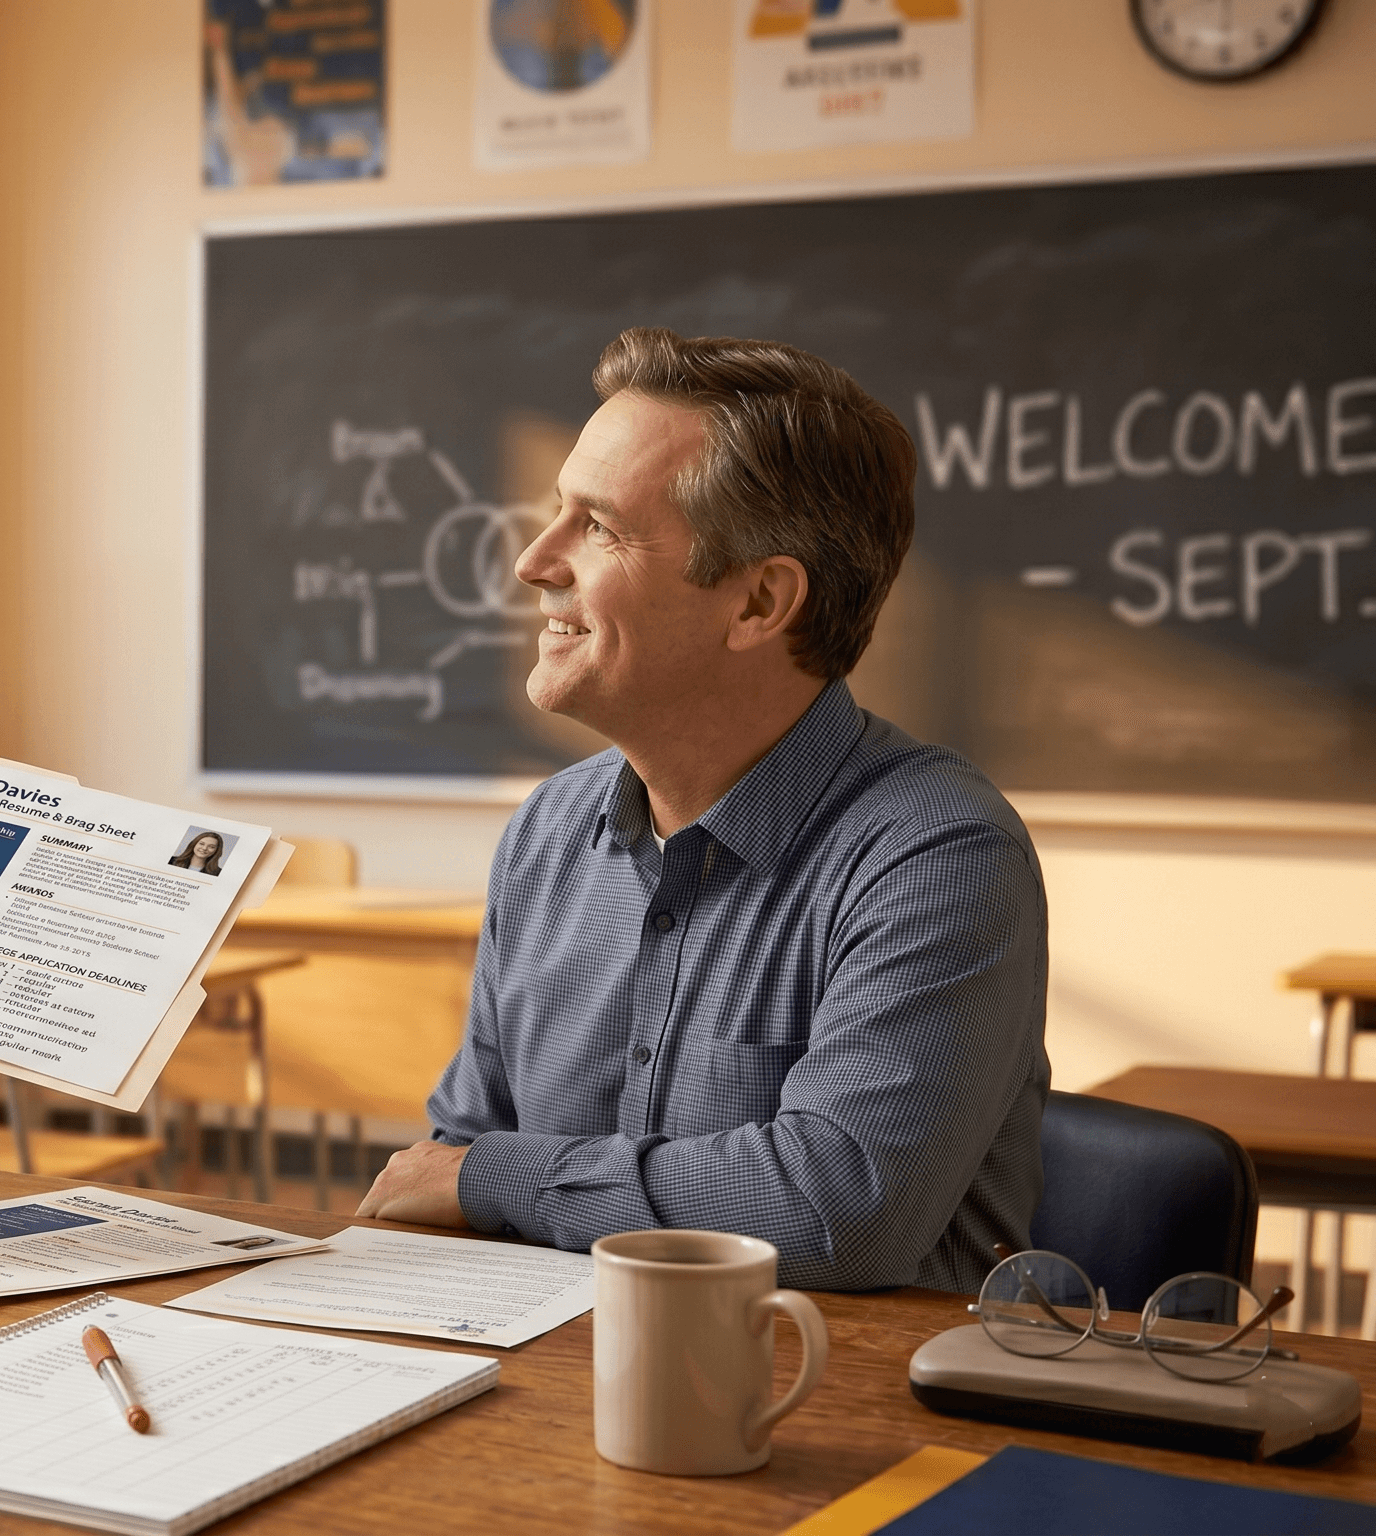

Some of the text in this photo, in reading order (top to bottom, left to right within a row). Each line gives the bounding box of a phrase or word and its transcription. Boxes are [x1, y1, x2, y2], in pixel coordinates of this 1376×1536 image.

[915, 375, 1376, 489] WELCOME
[52, 812, 63, 822] &
[64, 815, 96, 832] Brag
[97, 823, 137, 840] Sheet
[40, 834, 93, 853] SUMMARY
[18, 952, 87, 977] APPLICATION
